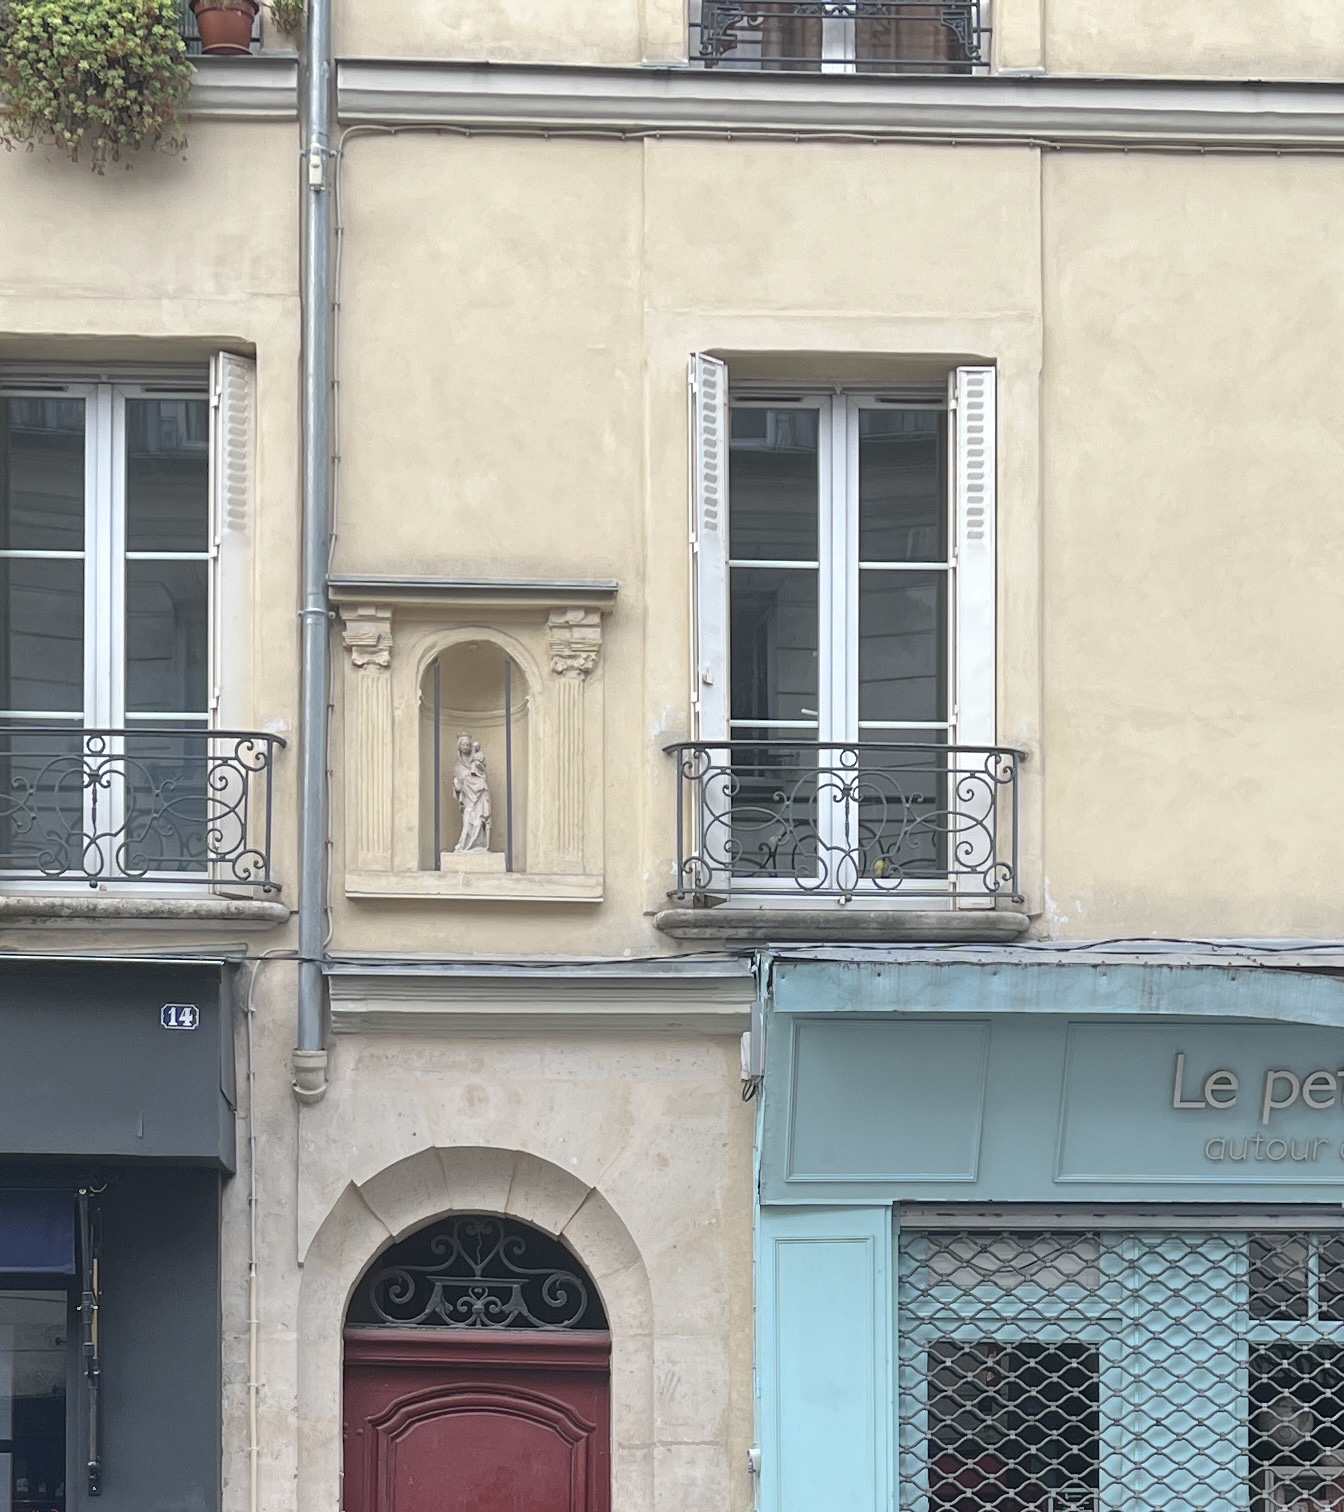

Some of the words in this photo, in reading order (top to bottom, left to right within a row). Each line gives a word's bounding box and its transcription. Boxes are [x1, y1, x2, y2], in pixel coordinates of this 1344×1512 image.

[168, 1006, 194, 1027] 14
[1172, 1053, 1239, 1109] Le
[1205, 1133, 1329, 1162] autour
